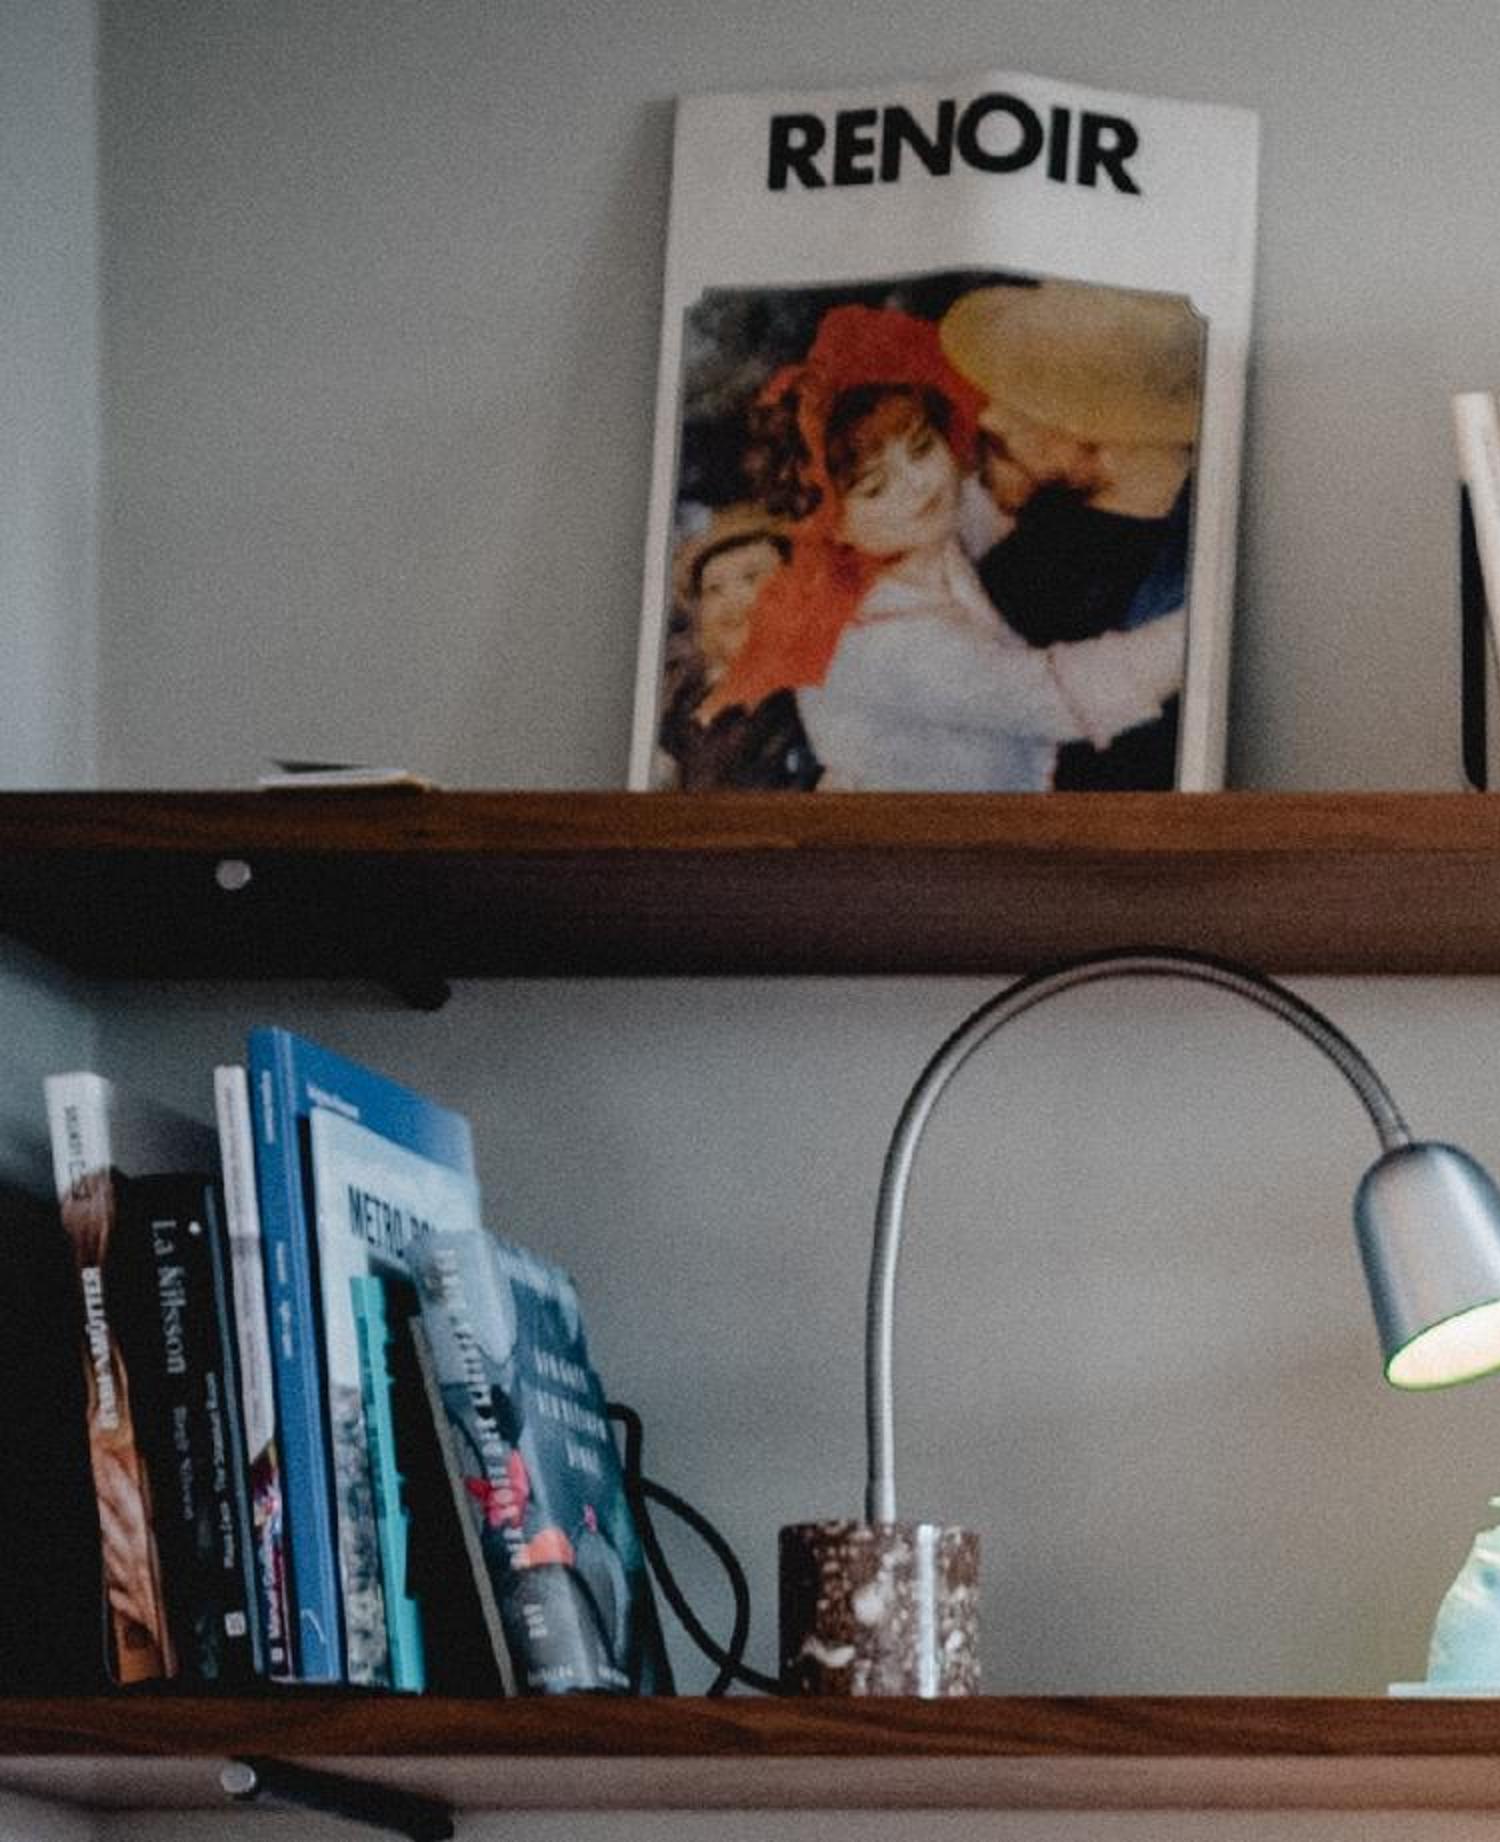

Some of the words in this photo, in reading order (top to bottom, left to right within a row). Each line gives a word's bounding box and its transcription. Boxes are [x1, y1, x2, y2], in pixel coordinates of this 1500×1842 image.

[768, 92, 1141, 196] RENOIR
[151, 1220, 177, 1256] La
[157, 1265, 187, 1374] Nilsson
